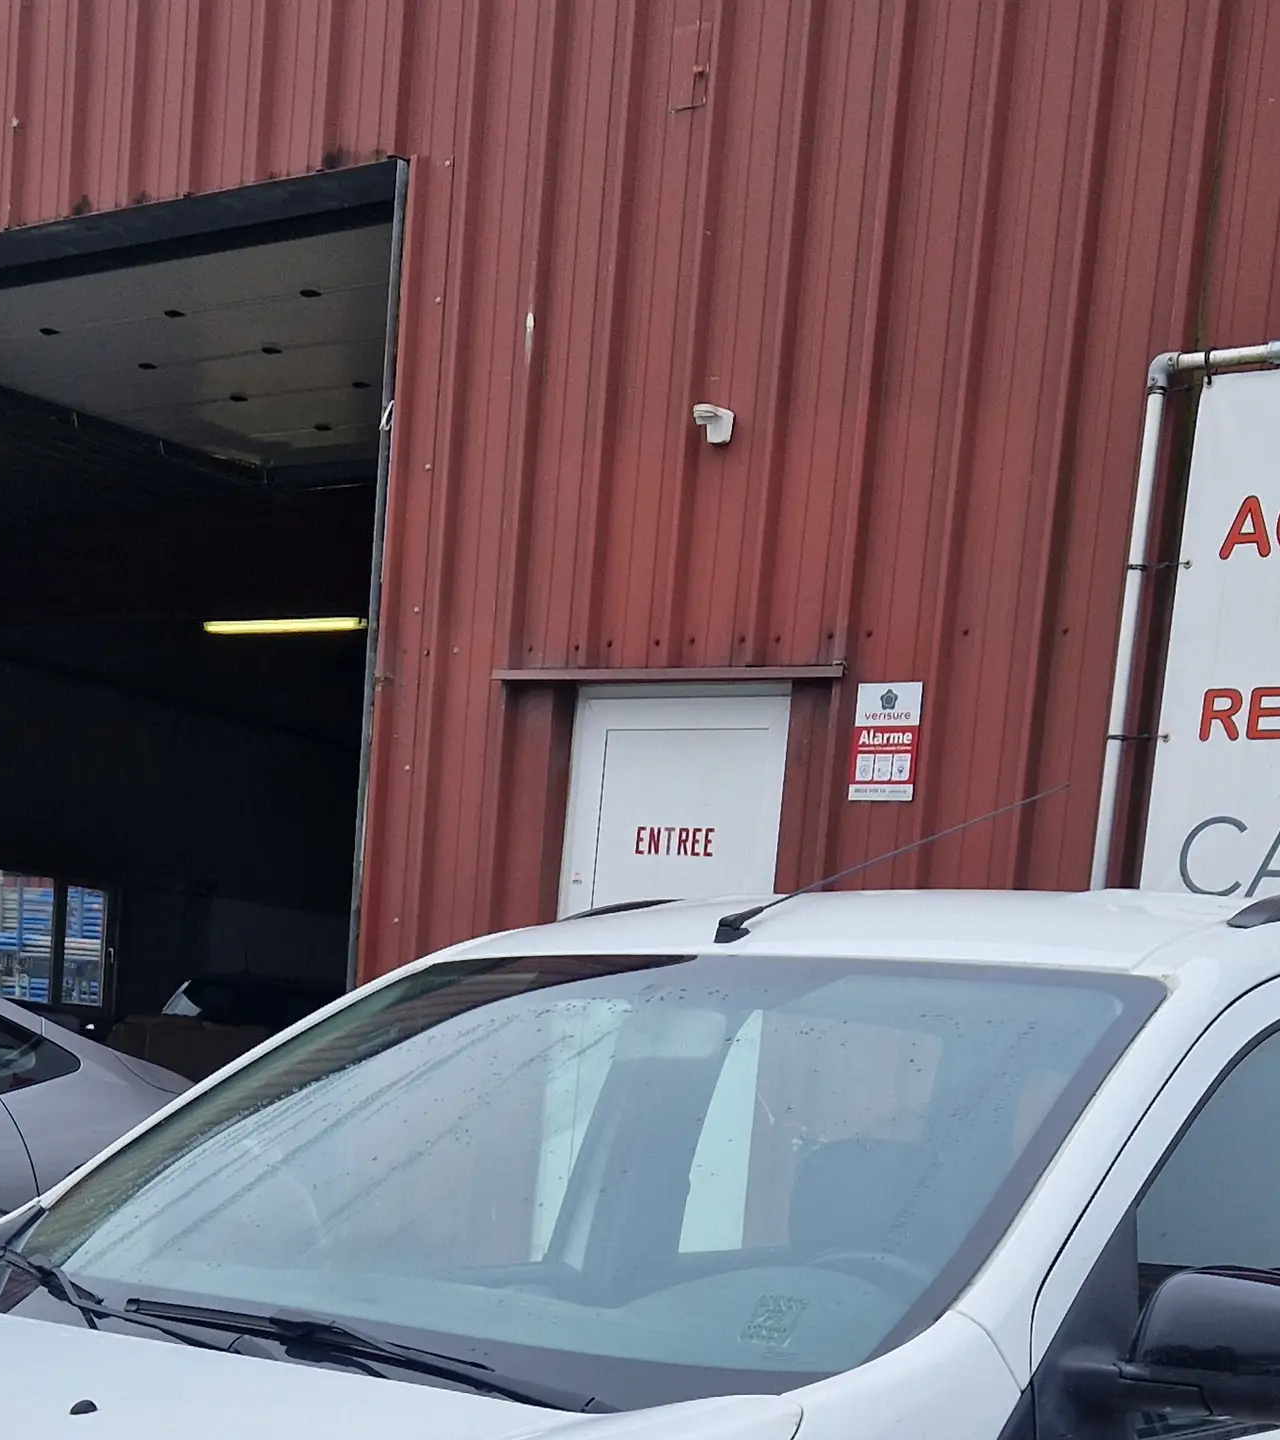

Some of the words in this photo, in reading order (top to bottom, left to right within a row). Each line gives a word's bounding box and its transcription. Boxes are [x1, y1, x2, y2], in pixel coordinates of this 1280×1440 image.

[864, 711, 911, 720] verisure
[858, 729, 912, 745] Alarme
[635, 826, 715, 857] ENTREE
